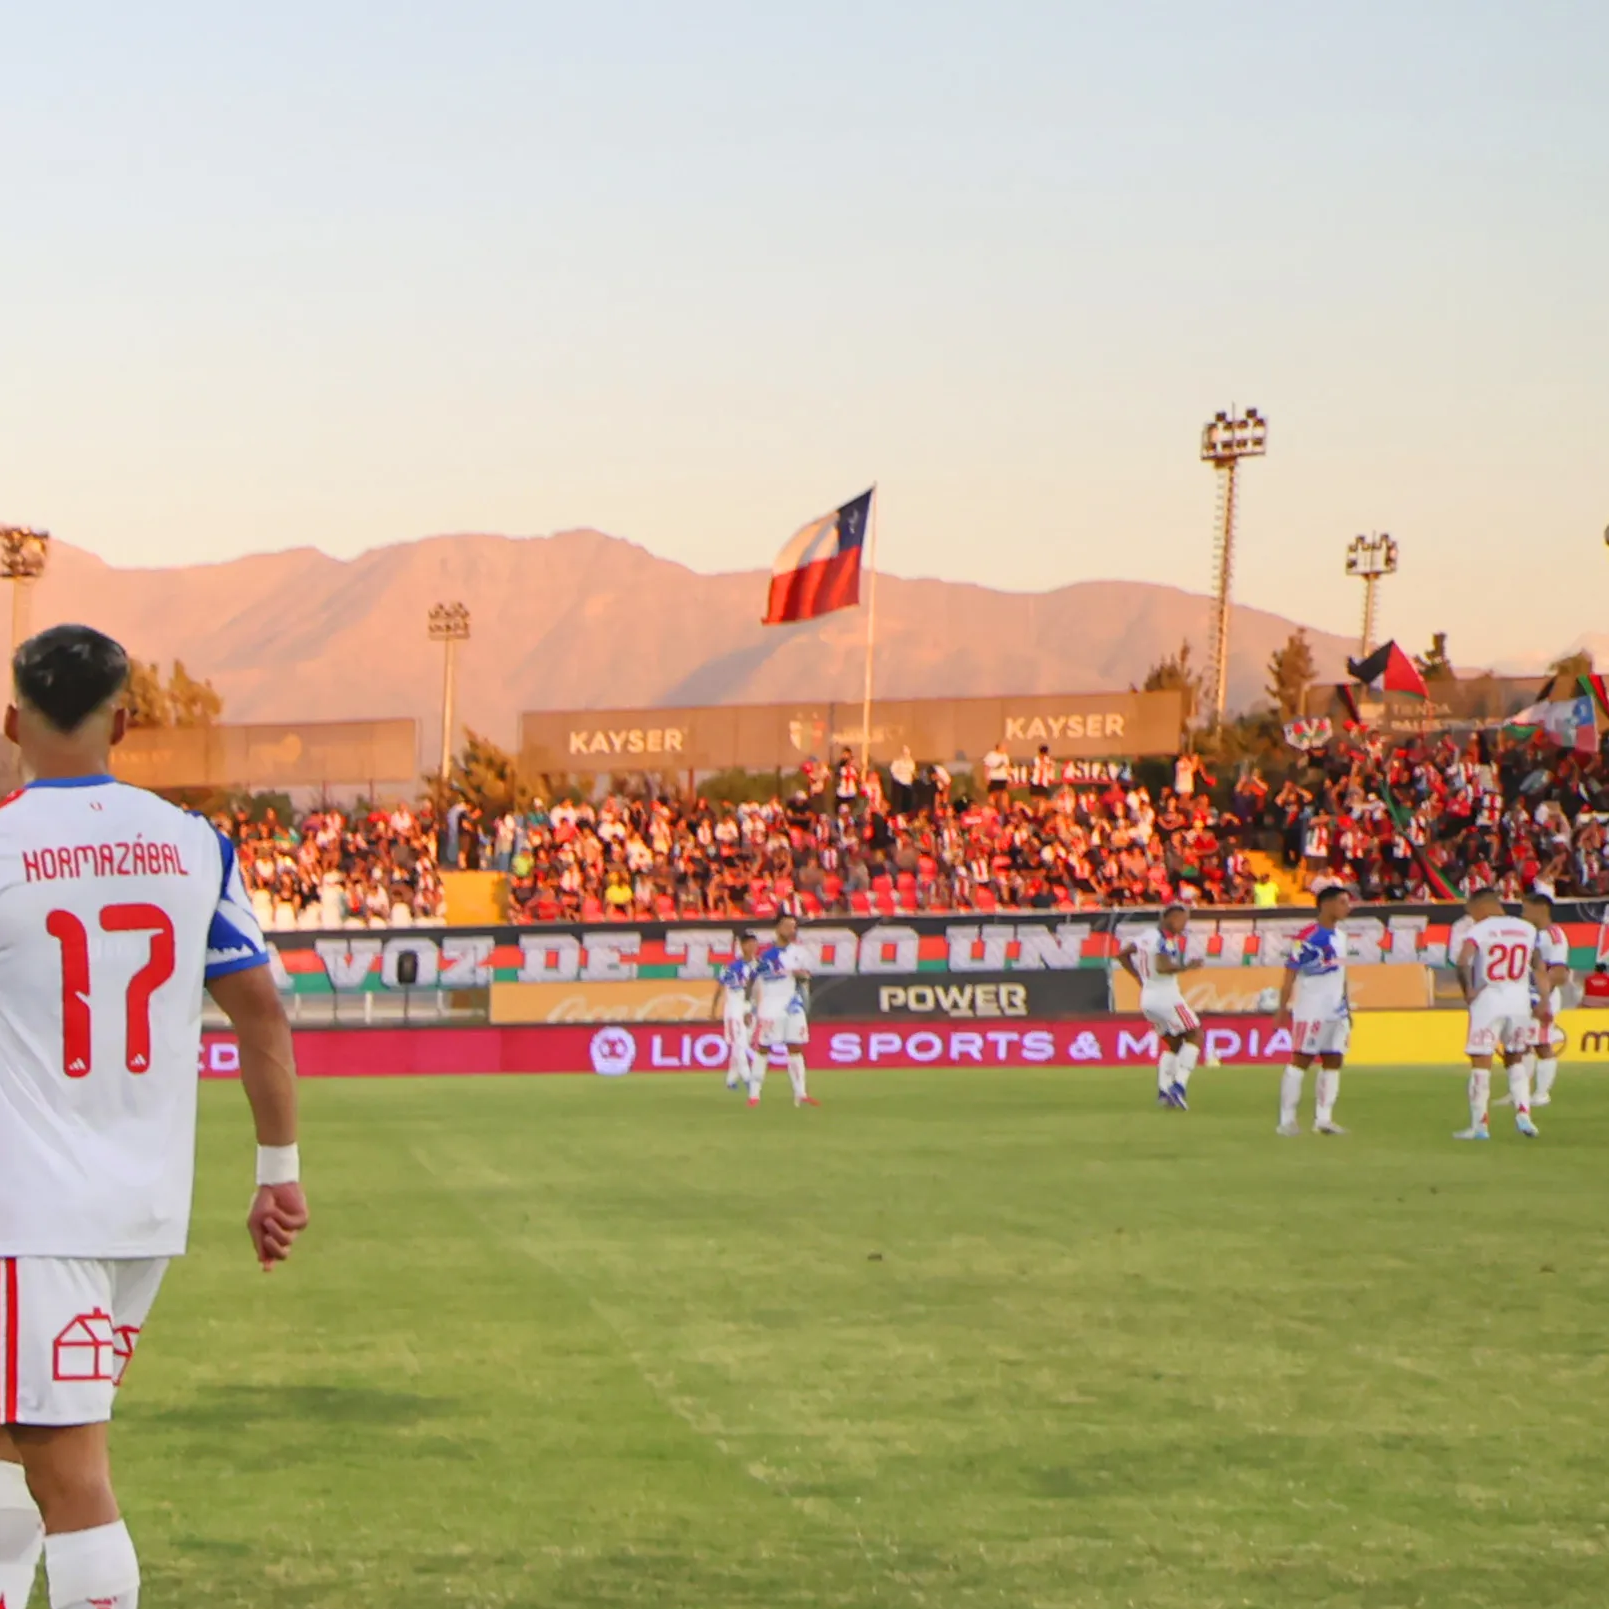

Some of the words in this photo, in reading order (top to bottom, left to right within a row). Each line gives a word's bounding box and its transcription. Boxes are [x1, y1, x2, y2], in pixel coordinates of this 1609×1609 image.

[569, 729, 684, 754] KAYSER
[1005, 713, 1125, 740] KAYSER
[23, 833, 190, 883] HORMAZÁBAL
[315, 935, 496, 988] VOZ
[518, 930, 642, 983] DE
[665, 925, 921, 980] TDO
[945, 922, 1092, 972] UN
[1487, 943, 1529, 981] 20
[46, 903, 176, 1078] 17
[879, 982, 1029, 1014] POWER
[651, 1034, 790, 1066] LIOS
[829, 1031, 1055, 1062] SPORTS
[1068, 1030, 1104, 1060] &
[1117, 1028, 1293, 1060] MDIA
